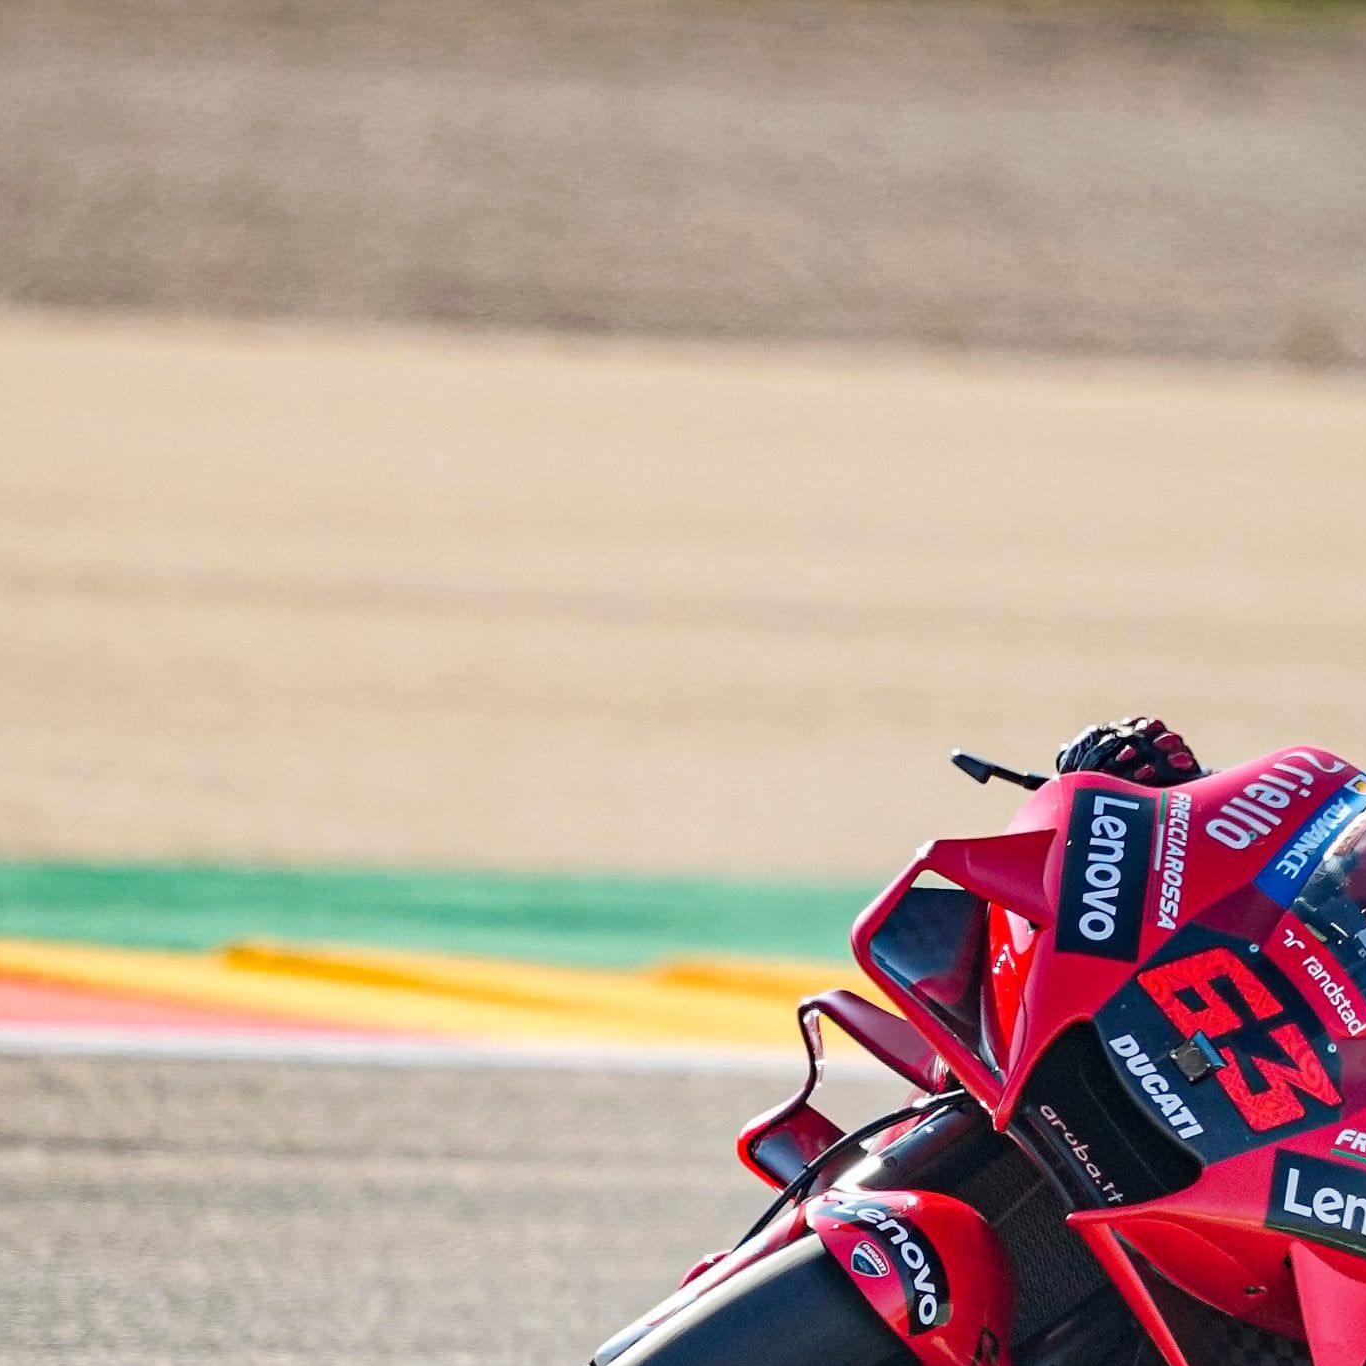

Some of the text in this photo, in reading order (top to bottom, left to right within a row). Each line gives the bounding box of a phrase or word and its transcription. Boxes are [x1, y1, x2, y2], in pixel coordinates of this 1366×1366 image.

[1157, 792, 1192, 931] FRECCIAROSSA
[1206, 763, 1315, 850] riello
[1275, 797, 1352, 880] ADVANCE
[1078, 796, 1140, 941] Lenovo
[1109, 1034, 1204, 1140] DUCATI
[1138, 947, 1343, 1132] 63
[1040, 1105, 1124, 1204] aruba.it
[833, 1202, 938, 1326] Lenovo
